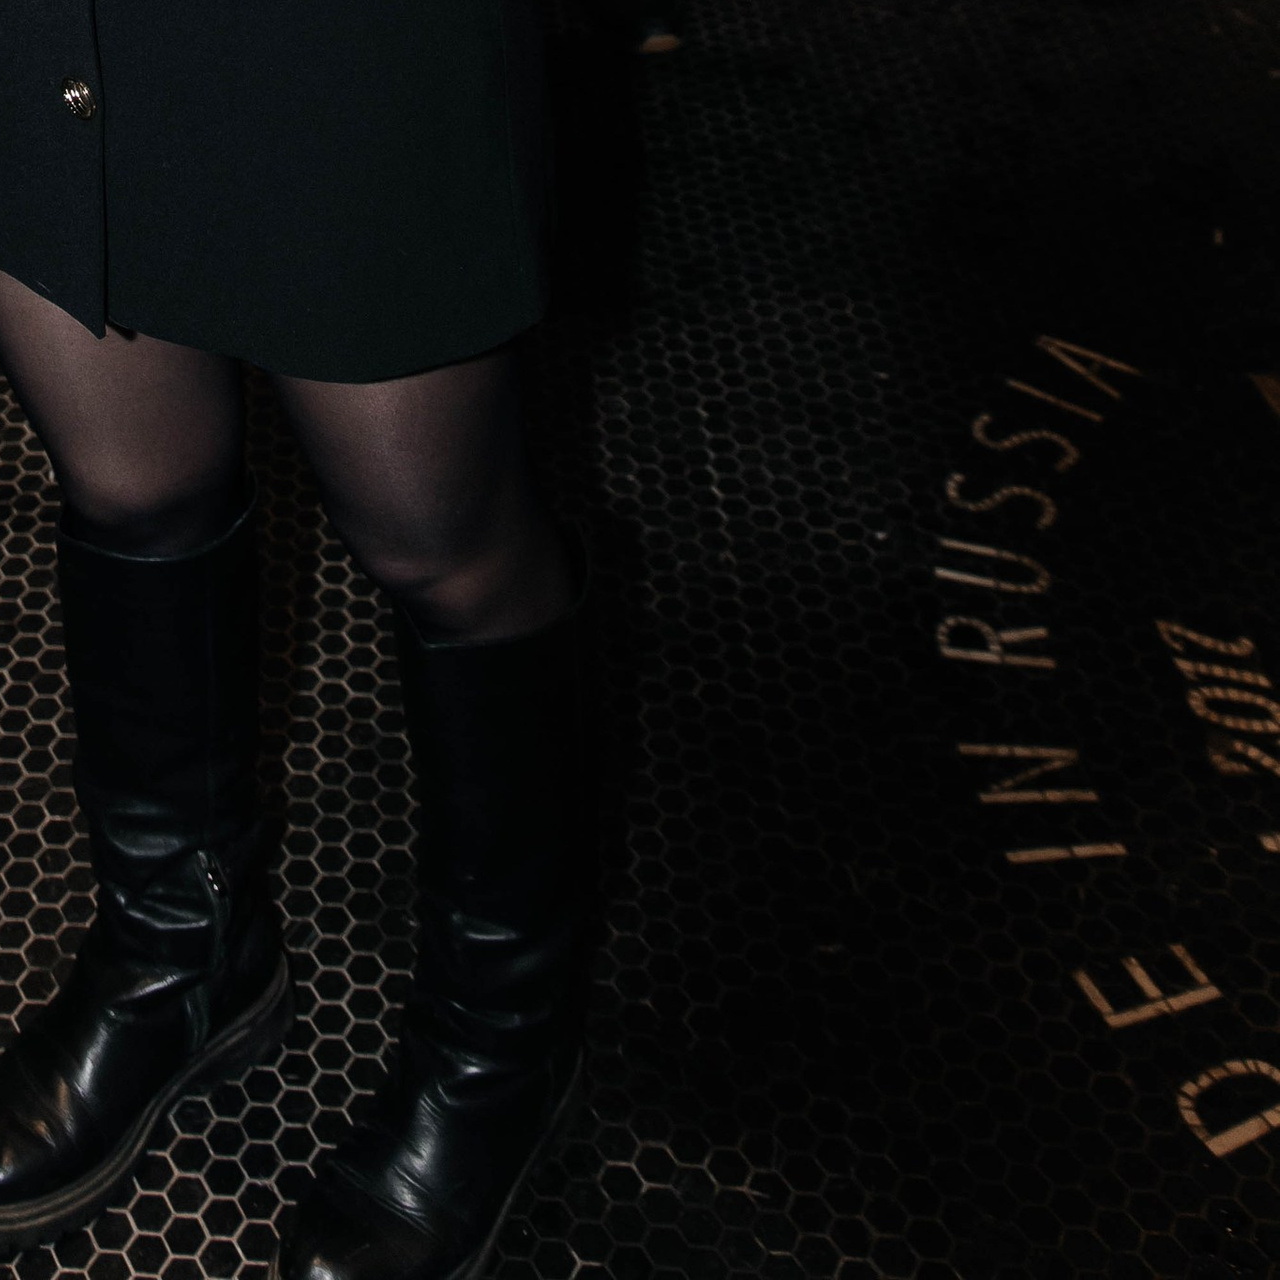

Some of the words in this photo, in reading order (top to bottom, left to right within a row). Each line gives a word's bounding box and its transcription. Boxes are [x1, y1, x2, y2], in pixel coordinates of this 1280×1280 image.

[933, 334, 1146, 671] RUSSIA
[956, 741, 1130, 866] IN
[1070, 942, 1280, 1158] DE
